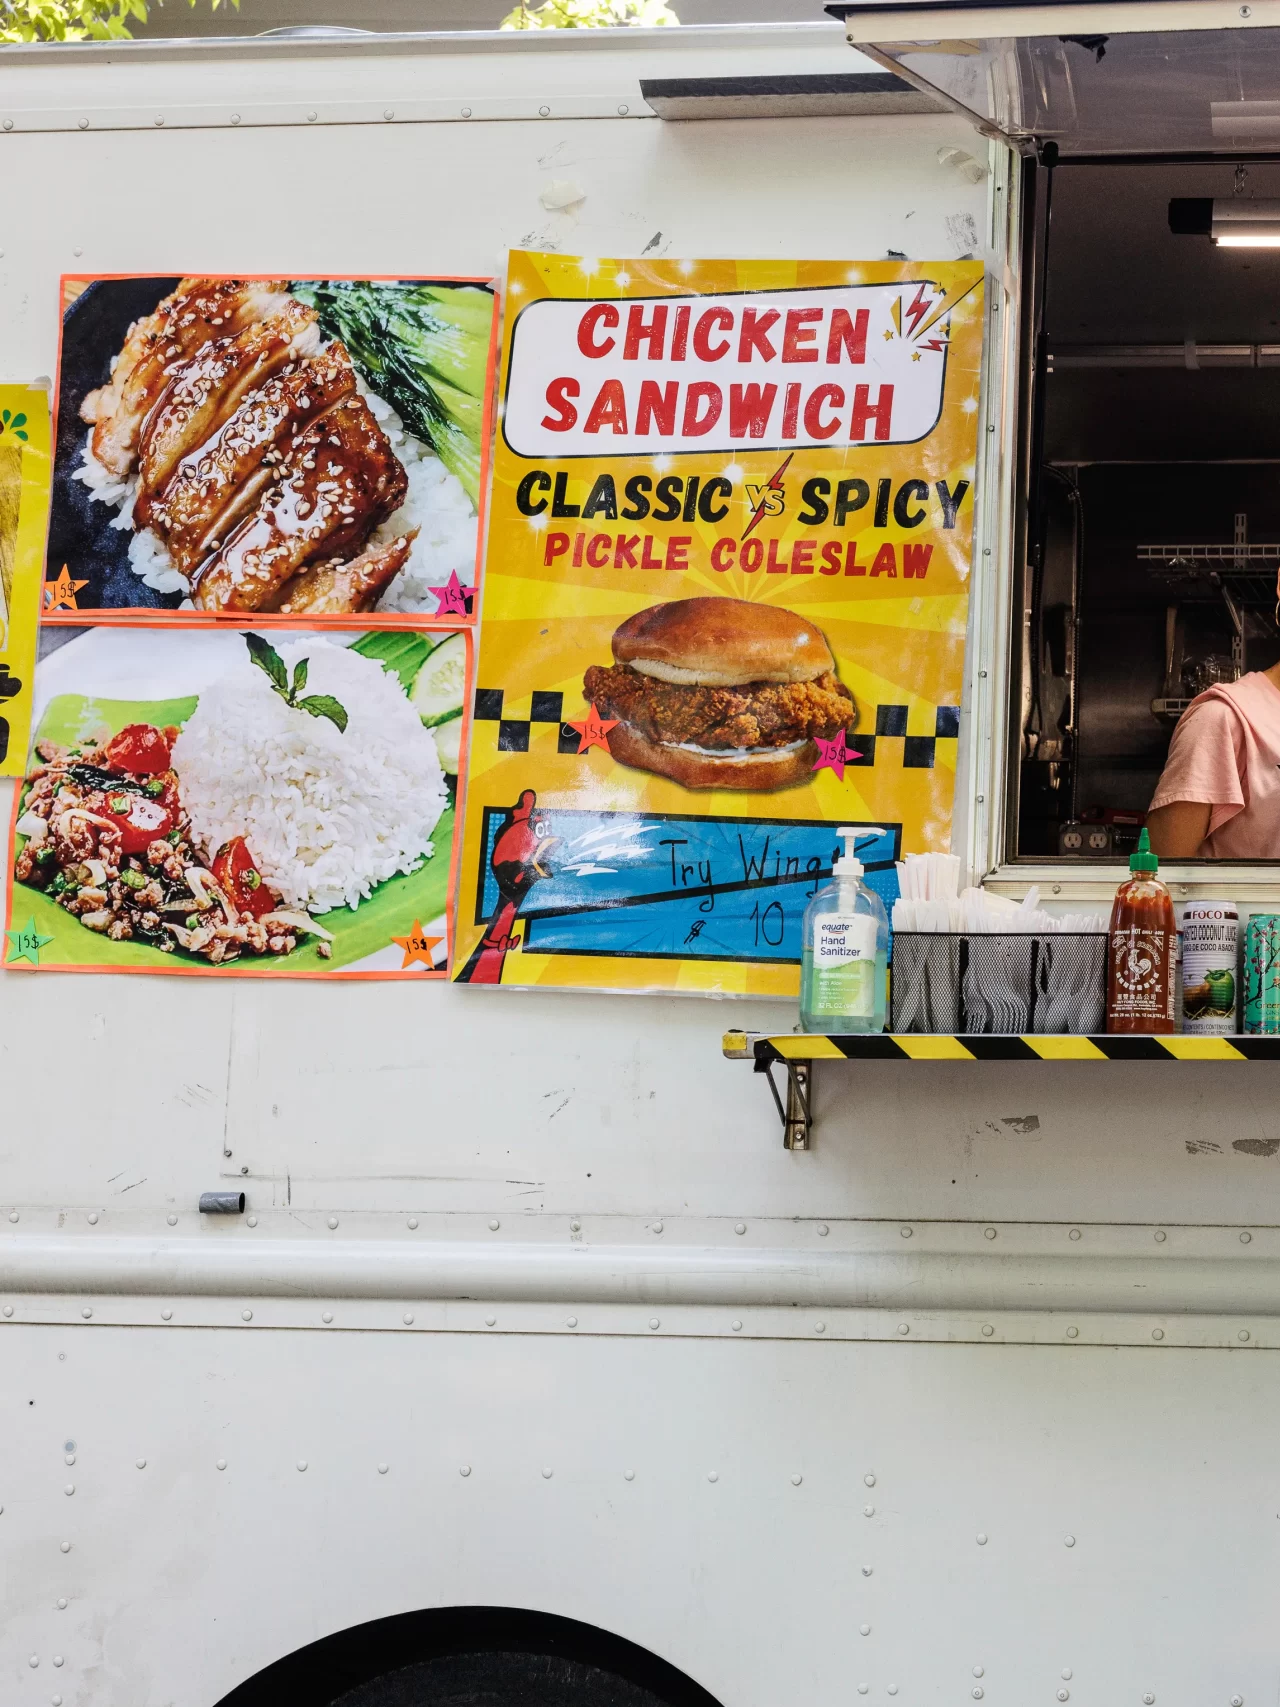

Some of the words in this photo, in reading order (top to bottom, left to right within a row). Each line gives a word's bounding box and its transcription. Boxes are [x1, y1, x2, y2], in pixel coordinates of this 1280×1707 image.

[577, 303, 871, 364] CHICKEN
[540, 376, 895, 440] SANDWICH
[516, 470, 732, 523] CLASSIC
[797, 477, 970, 529] SPICY
[543, 531, 692, 570] PICKLE
[710, 536, 934, 579] COLESLAW
[584, 723, 606, 740] 15$
[824, 745, 847, 763] 15$
[659, 839, 714, 912] Try
[750, 900, 784, 947] 10
[1192, 910, 1223, 920] FOCO
[821, 936, 846, 945] Hand
[1199, 924, 1225, 941] COCONUT
[18, 934, 40, 952] 15$
[820, 947, 861, 956] Sanitizer
